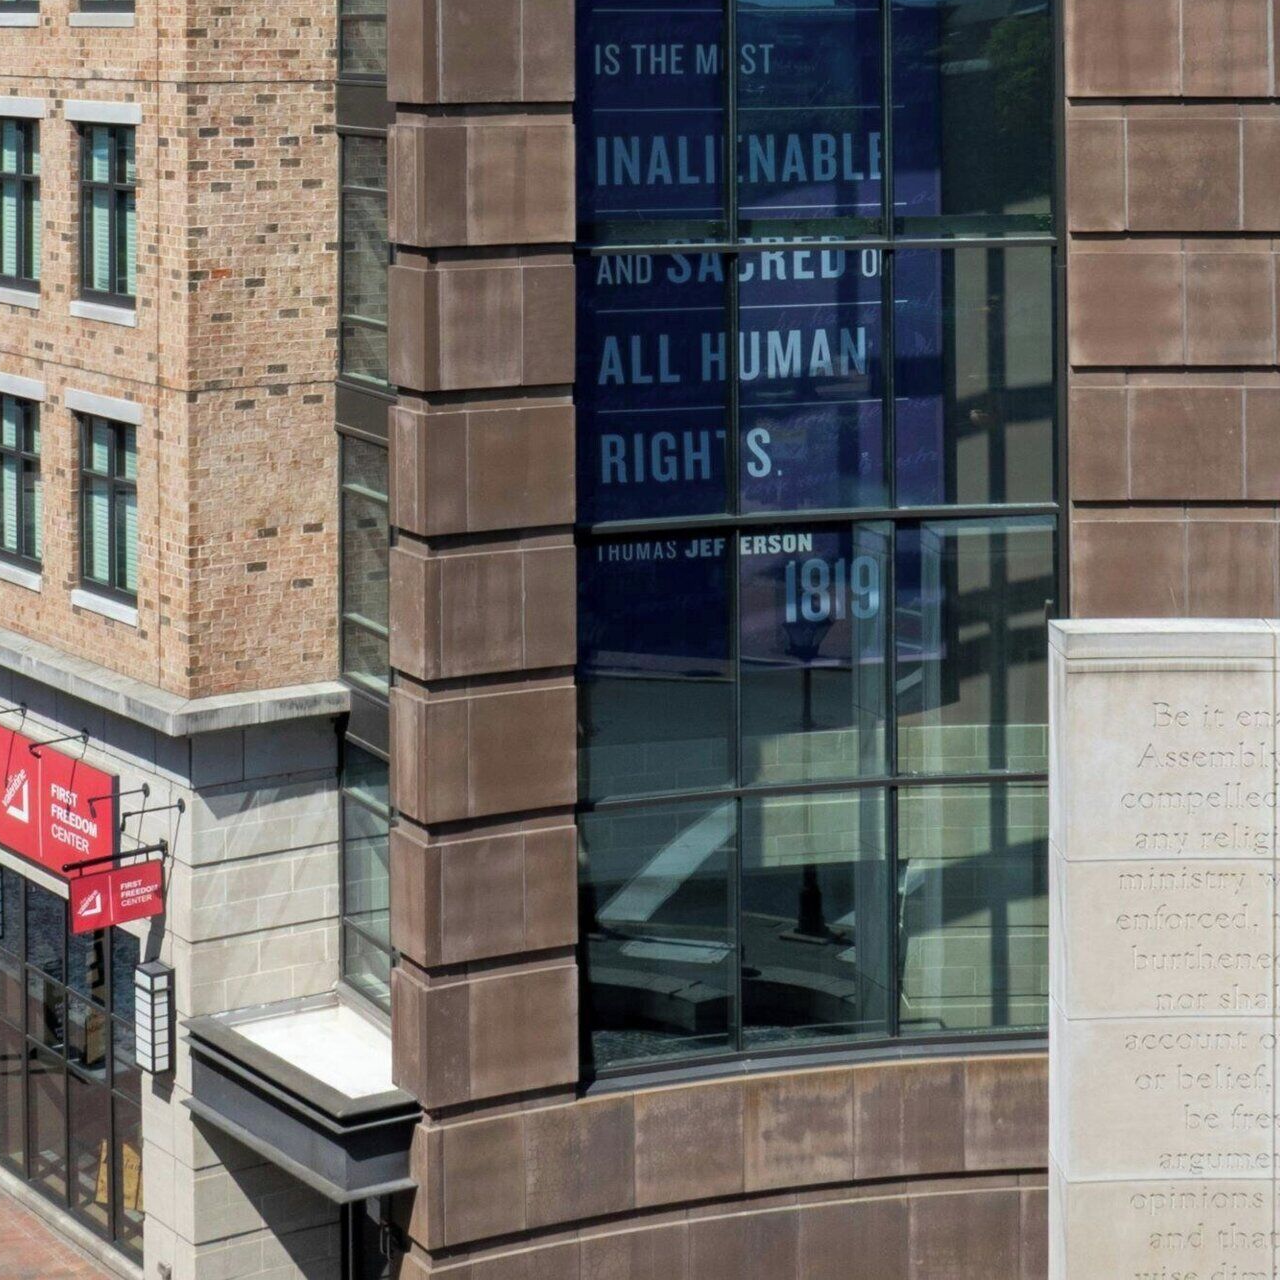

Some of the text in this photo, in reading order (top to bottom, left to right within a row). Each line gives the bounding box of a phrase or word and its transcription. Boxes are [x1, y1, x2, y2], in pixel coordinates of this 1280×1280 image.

[595, 44, 775, 76] IS THE MST
[596, 236, 882, 286] AND SACRED O
[598, 327, 867, 385] ALL HUMAN
[684, 532, 813, 559] JEFERSON
[784, 555, 880, 624] 1819
[1152, 702, 1190, 728] Be
[1203, 704, 1225, 728] it
[50, 783, 78, 807] FIRST
[1120, 782, 1280, 816] compelled
[51, 803, 98, 838] FREEDOM
[51, 823, 90, 855] CENTER
[1135, 831, 1188, 855] any
[120, 879, 142, 890] FIRST
[1119, 866, 1246, 897] ministry
[121, 894, 152, 907] CENTER
[1156, 992, 1209, 1011] nor
[1124, 1030, 1248, 1051] account
[1135, 1073, 1166, 1090] or
[1184, 1103, 1220, 1130] be
[1130, 1186, 1264, 1216] opinions
[1149, 1222, 1204, 1250] and
[1218, 1222, 1280, 1250] that
